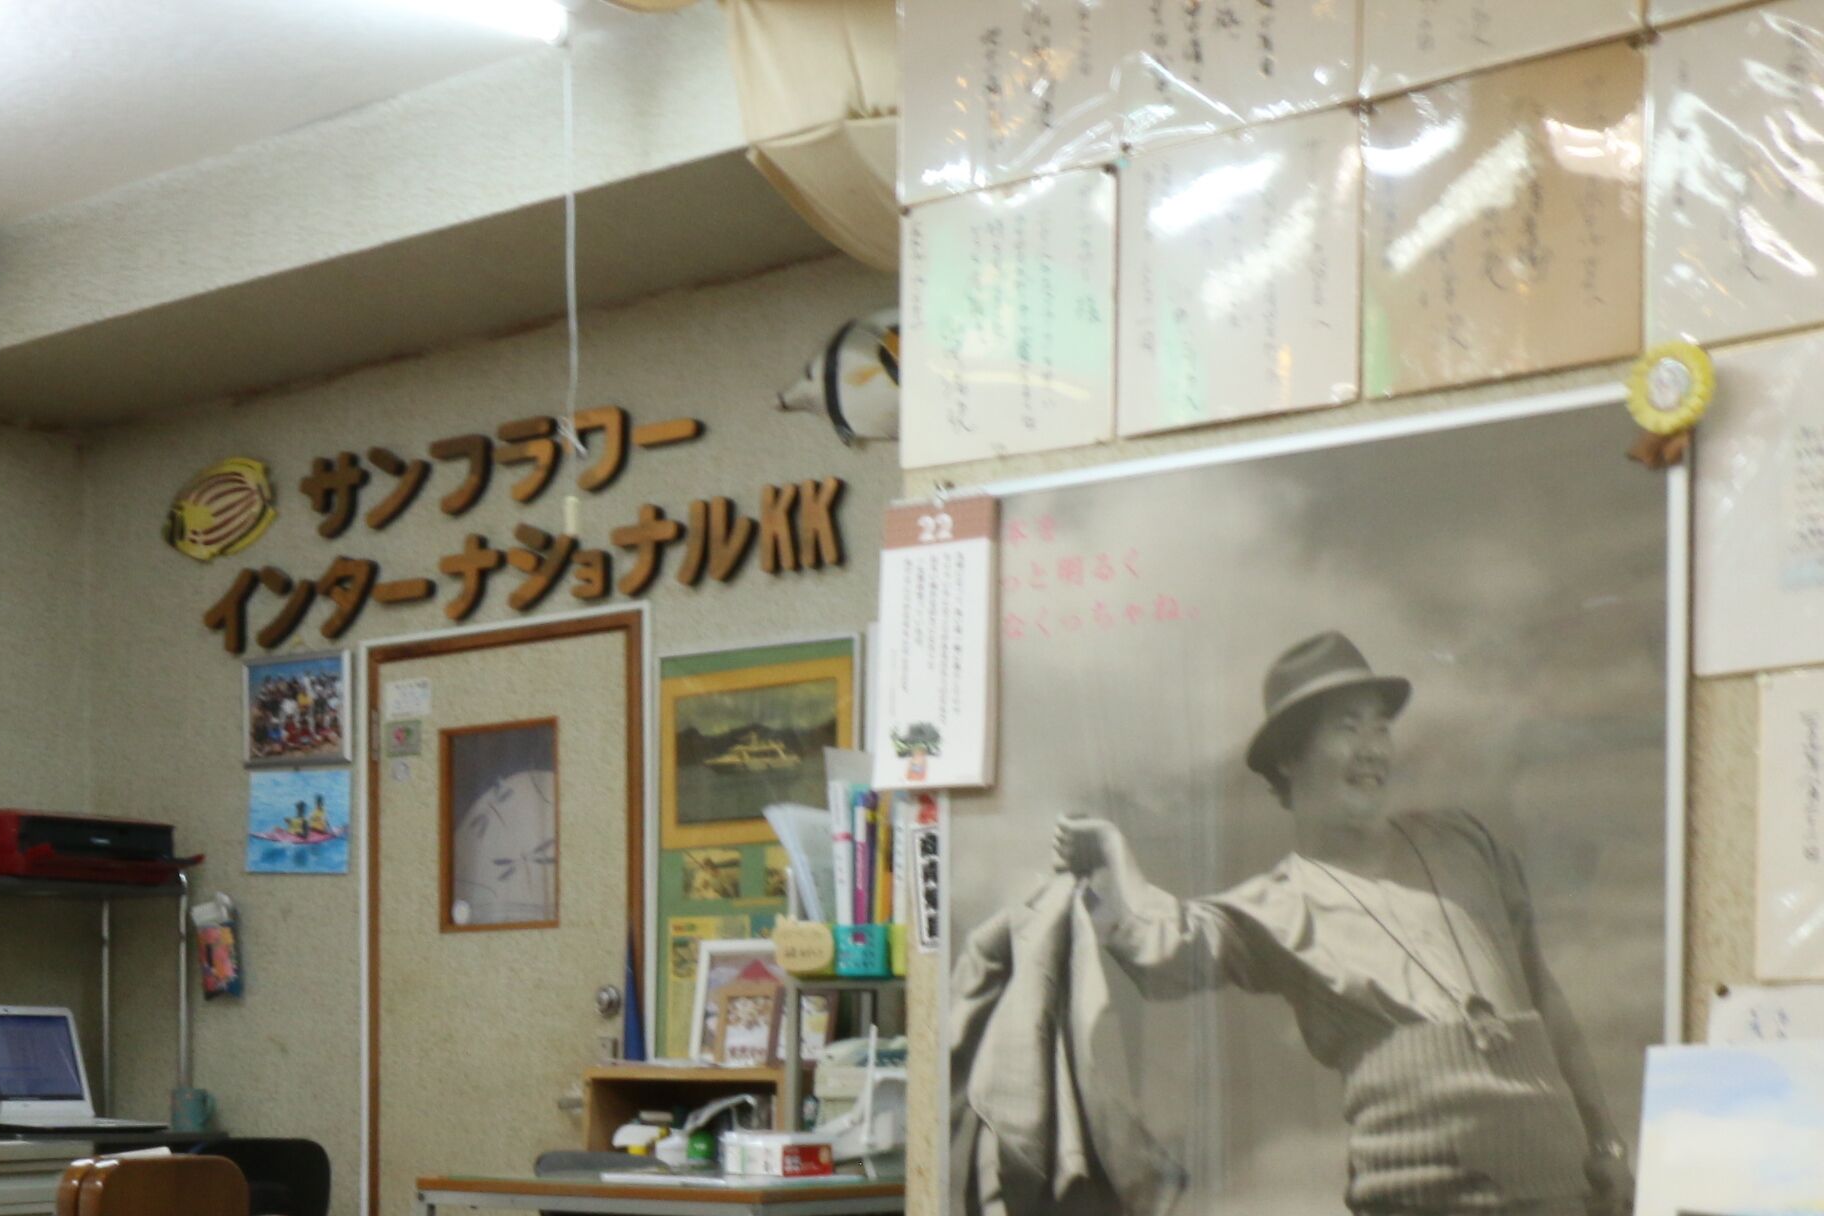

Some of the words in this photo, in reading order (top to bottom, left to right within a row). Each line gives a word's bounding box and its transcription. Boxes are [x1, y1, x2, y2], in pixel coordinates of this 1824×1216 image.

[299, 404, 702, 539] サンフラワー
[917, 513, 954, 542] 22
